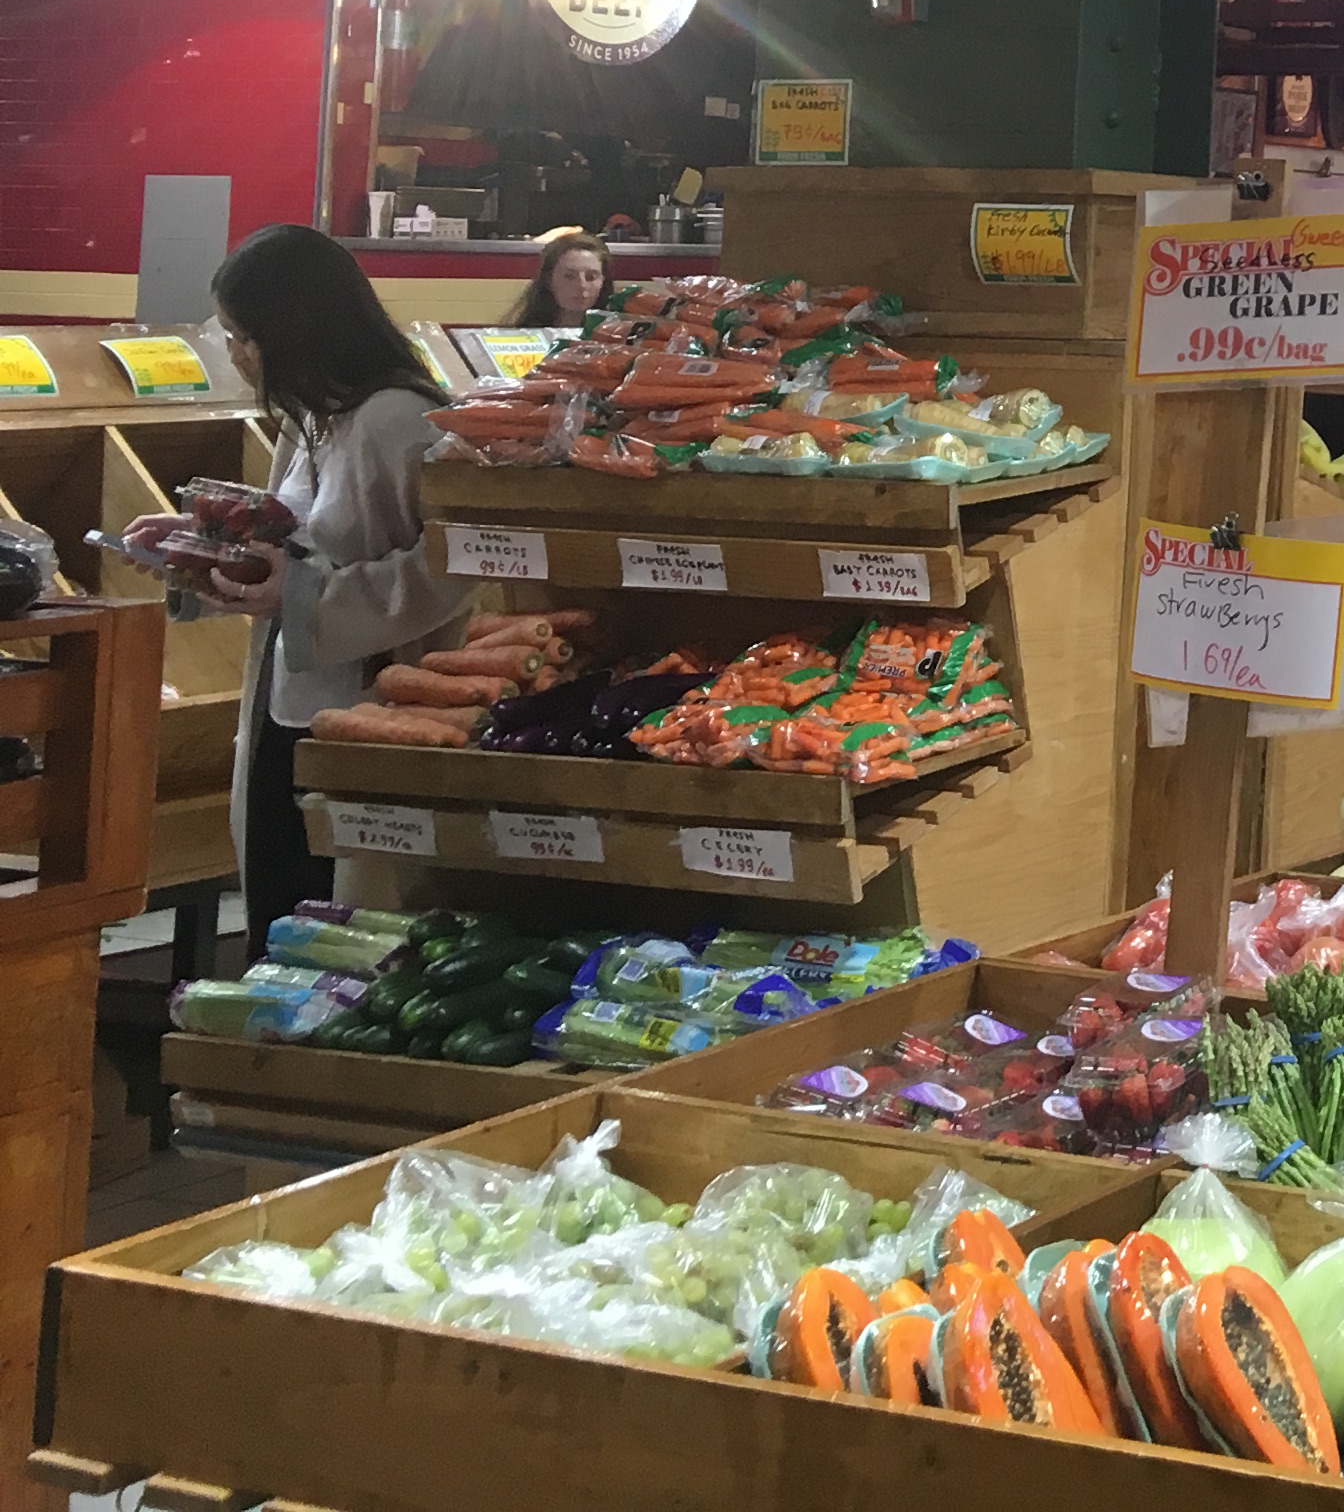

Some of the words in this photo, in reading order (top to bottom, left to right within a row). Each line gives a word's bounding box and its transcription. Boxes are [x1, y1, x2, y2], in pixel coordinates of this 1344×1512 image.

[568, 34, 611, 61] SINCE
[618, 42, 649, 60] 1954
[1144, 234, 1296, 296] SPECIAL
[1182, 271, 1295, 299] GREEN
[1229, 292, 1340, 319] GRAPE
[463, 542, 527, 557] CARROTS
[1140, 528, 1255, 576] SPECIAL
[867, 565, 917, 579] CARROTS
[786, 940, 840, 965] Dole
